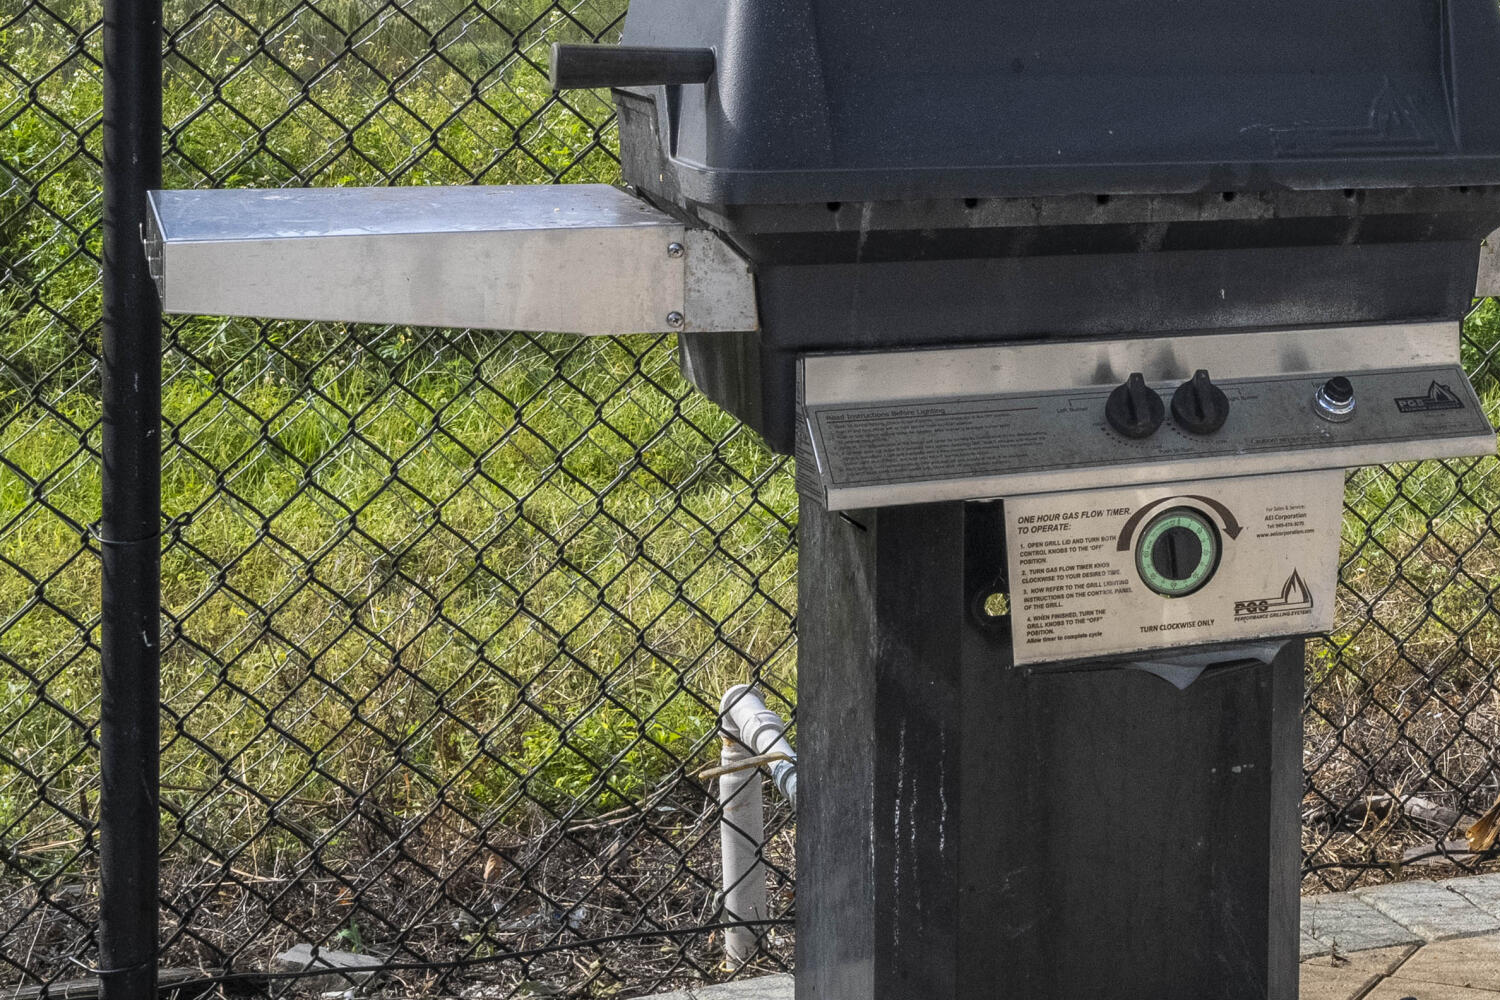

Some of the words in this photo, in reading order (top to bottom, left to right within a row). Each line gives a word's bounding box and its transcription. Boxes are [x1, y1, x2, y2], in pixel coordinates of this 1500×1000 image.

[1017, 516, 1035, 524] ONE
[1036, 513, 1061, 522] HOUR
[1062, 512, 1079, 520] GAS
[1081, 509, 1104, 519] FLOW
[1106, 507, 1132, 517] TIMER.
[1274, 513, 1307, 521] Corporation
[1017, 527, 1029, 535] TO
[1031, 523, 1071, 534] OPERATE:
[1027, 541, 1043, 549] OPEN
[1044, 539, 1060, 547] GRILL
[1059, 564, 1075, 572] FLOW
[1021, 575, 1055, 584] CLOCKWISE
[1065, 572, 1081, 580] YOUR
[1082, 570, 1106, 578] DESIRED
[1045, 585, 1064, 593] REFER
[1023, 594, 1064, 603] INSTRUCTIONS
[1065, 592, 1074, 600] ON
[1234, 600, 1268, 615] PGS
[1140, 625, 1158, 633] TURN
[1159, 621, 1196, 631] CLOCKWISE
[1197, 619, 1215, 628] ONLY
